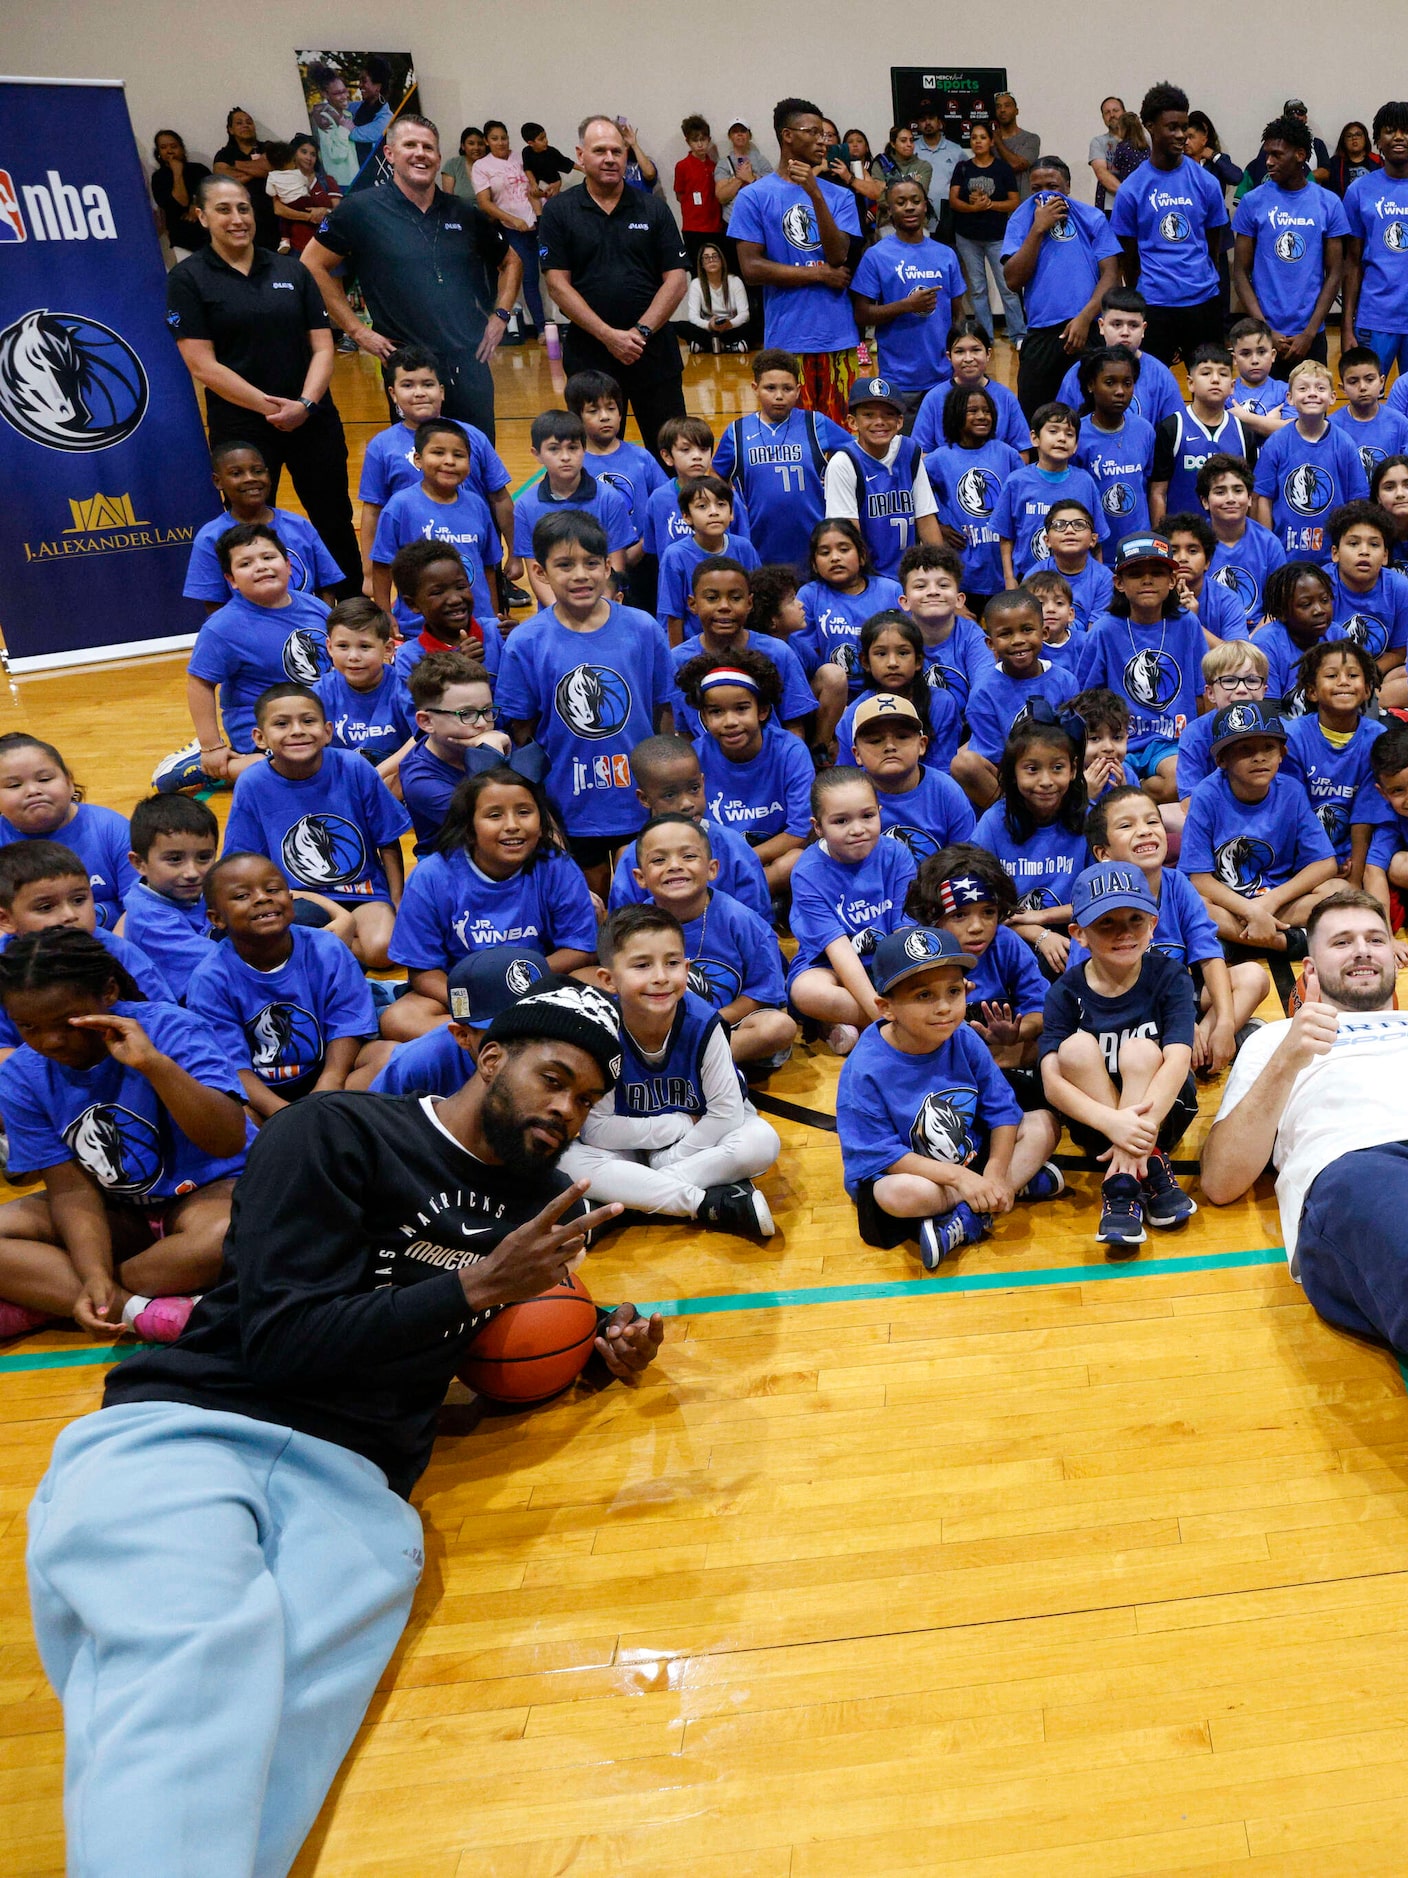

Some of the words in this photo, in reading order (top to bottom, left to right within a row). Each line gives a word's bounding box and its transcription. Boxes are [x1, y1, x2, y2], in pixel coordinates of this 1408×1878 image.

[936, 79, 979, 92] sports
[21, 170, 118, 241] nba
[1158, 198, 1193, 206] WNBA
[1277, 217, 1315, 226] WNBA
[905, 270, 943, 279] WNBA
[748, 445, 803, 466] DALLAS
[1102, 460, 1118, 468] JR.
[1103, 463, 1142, 476] WNBA
[775, 465, 805, 493] 77
[154, 526, 194, 543] LAW
[435, 532, 478, 544] WNBA
[1286, 526, 1299, 551] jr.
[829, 616, 847, 626] JR.
[572, 756, 594, 796] jr.
[1310, 777, 1331, 786] JR.
[724, 799, 746, 810] JR.
[725, 801, 784, 822] WNBA
[1018, 857, 1043, 876] Time
[1045, 856, 1055, 875] To
[1056, 855, 1074, 875] Play
[1089, 871, 1142, 900] DAL
[846, 900, 870, 912] JR.
[470, 919, 494, 930] JR.
[471, 925, 539, 944] WNBA
